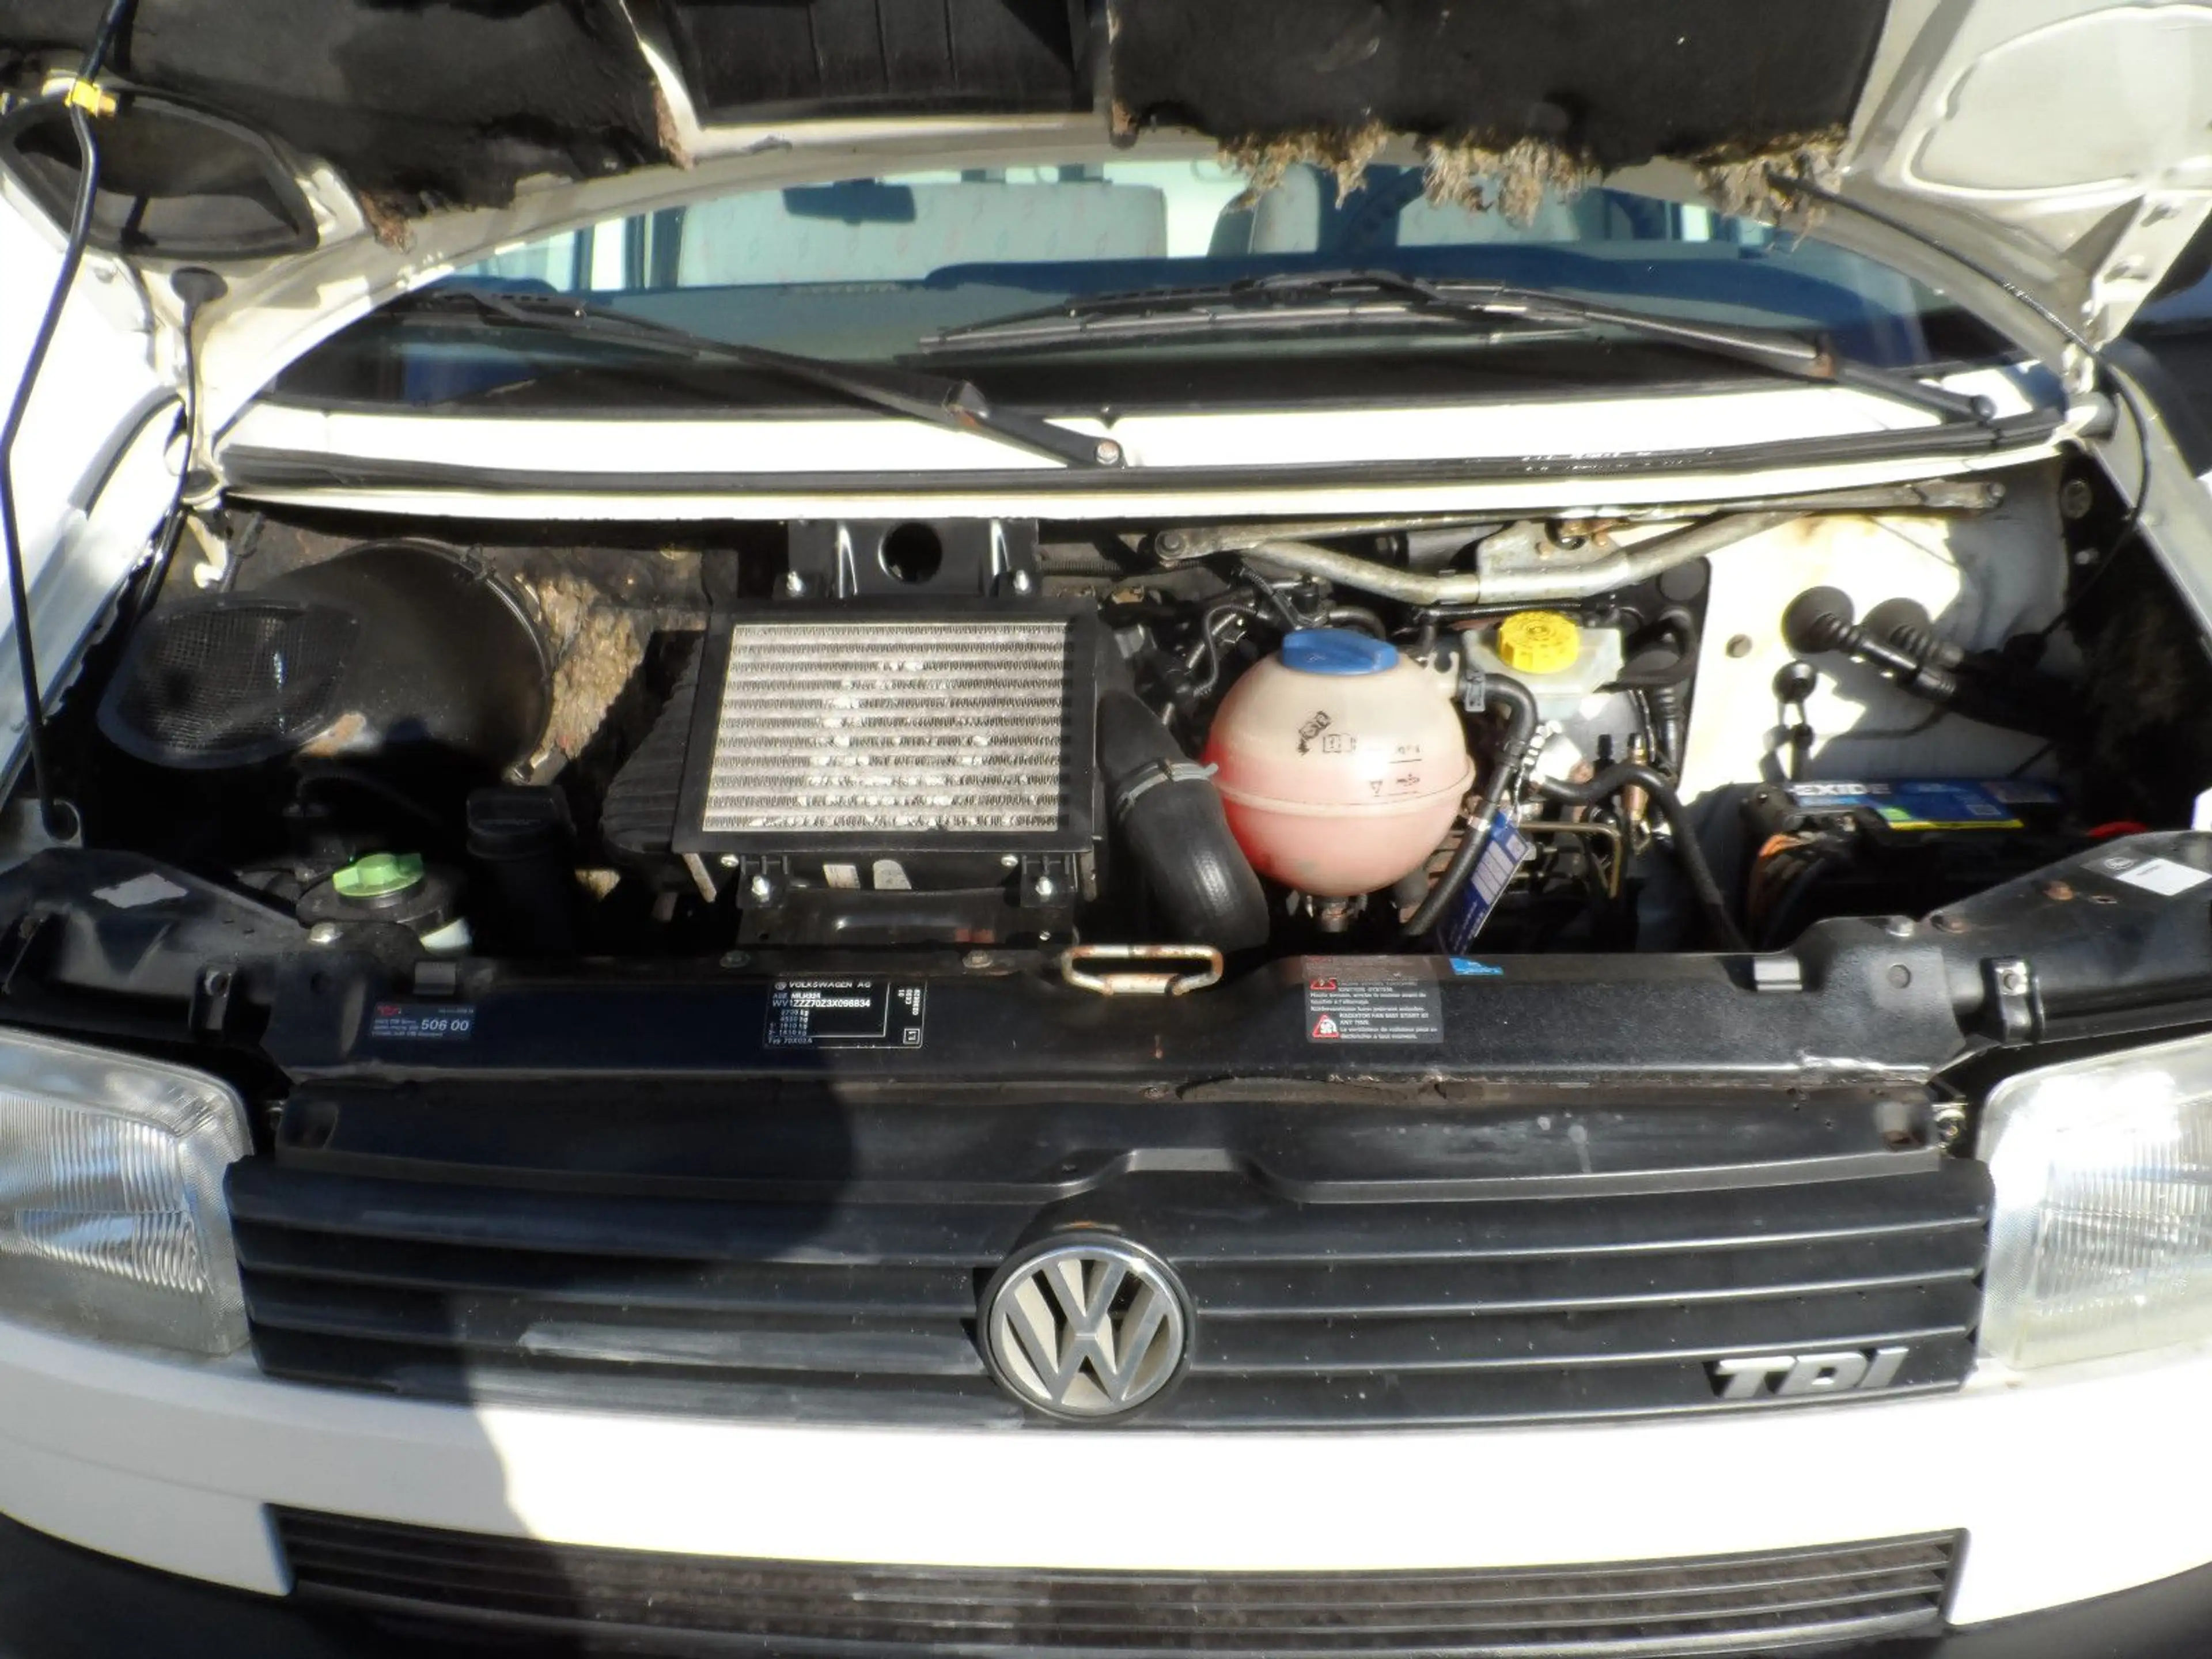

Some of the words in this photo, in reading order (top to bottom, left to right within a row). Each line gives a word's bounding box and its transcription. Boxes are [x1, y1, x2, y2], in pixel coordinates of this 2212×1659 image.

[1793, 783, 1892, 796] EXIDE
[421, 1019, 447, 1031] 506
[450, 1019, 469, 1031] 00
[1715, 1347, 1909, 1399] TDI
